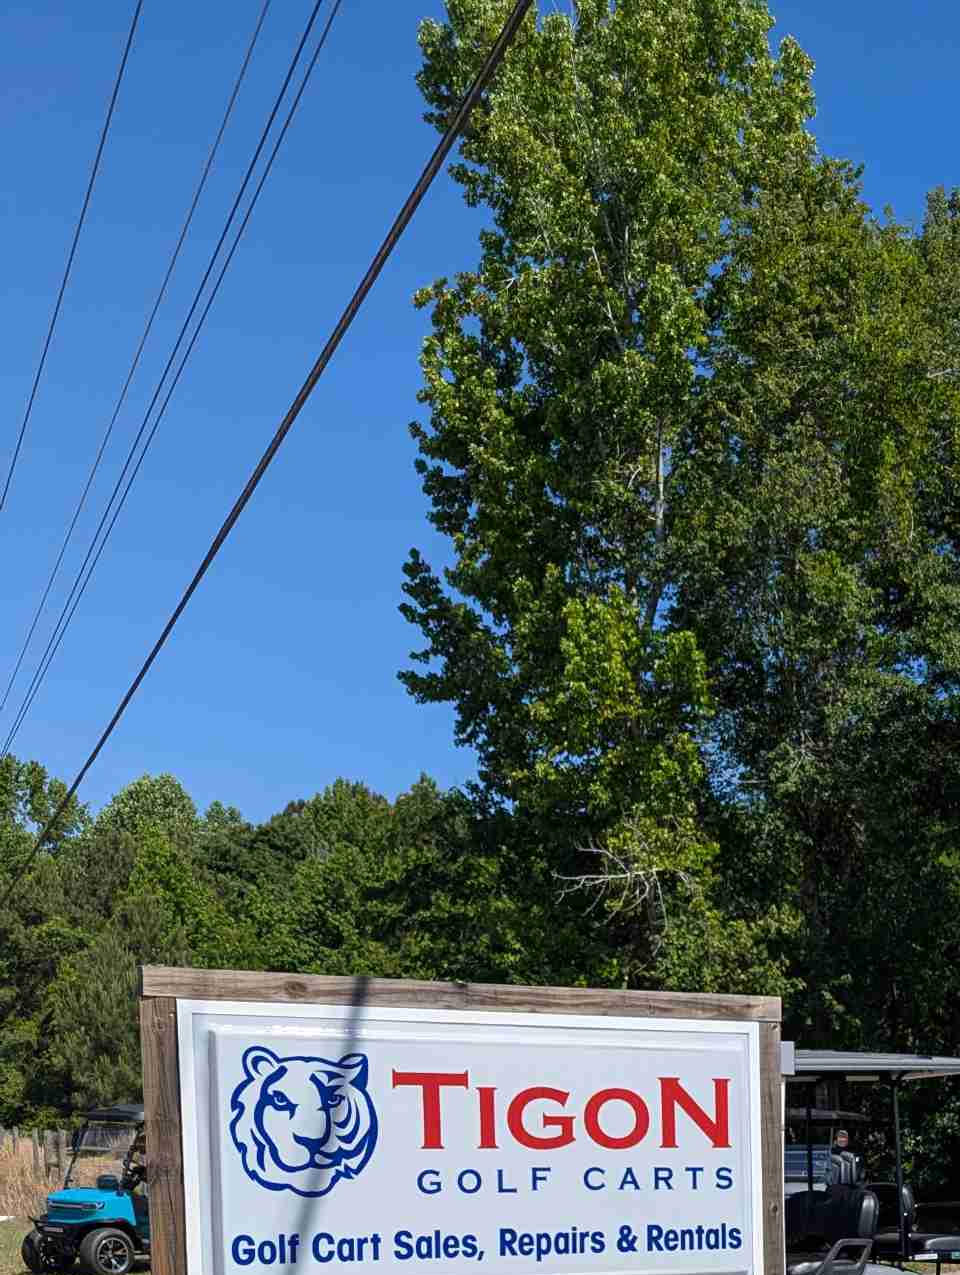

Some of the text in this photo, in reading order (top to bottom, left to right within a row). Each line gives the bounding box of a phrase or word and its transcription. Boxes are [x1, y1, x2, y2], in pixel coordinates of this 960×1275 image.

[391, 1070, 731, 1150] TIGON
[416, 1166, 735, 1195] GOLF CARTS
[230, 1222, 743, 1266] Golf Cart Sales, Repairs & Rentals
